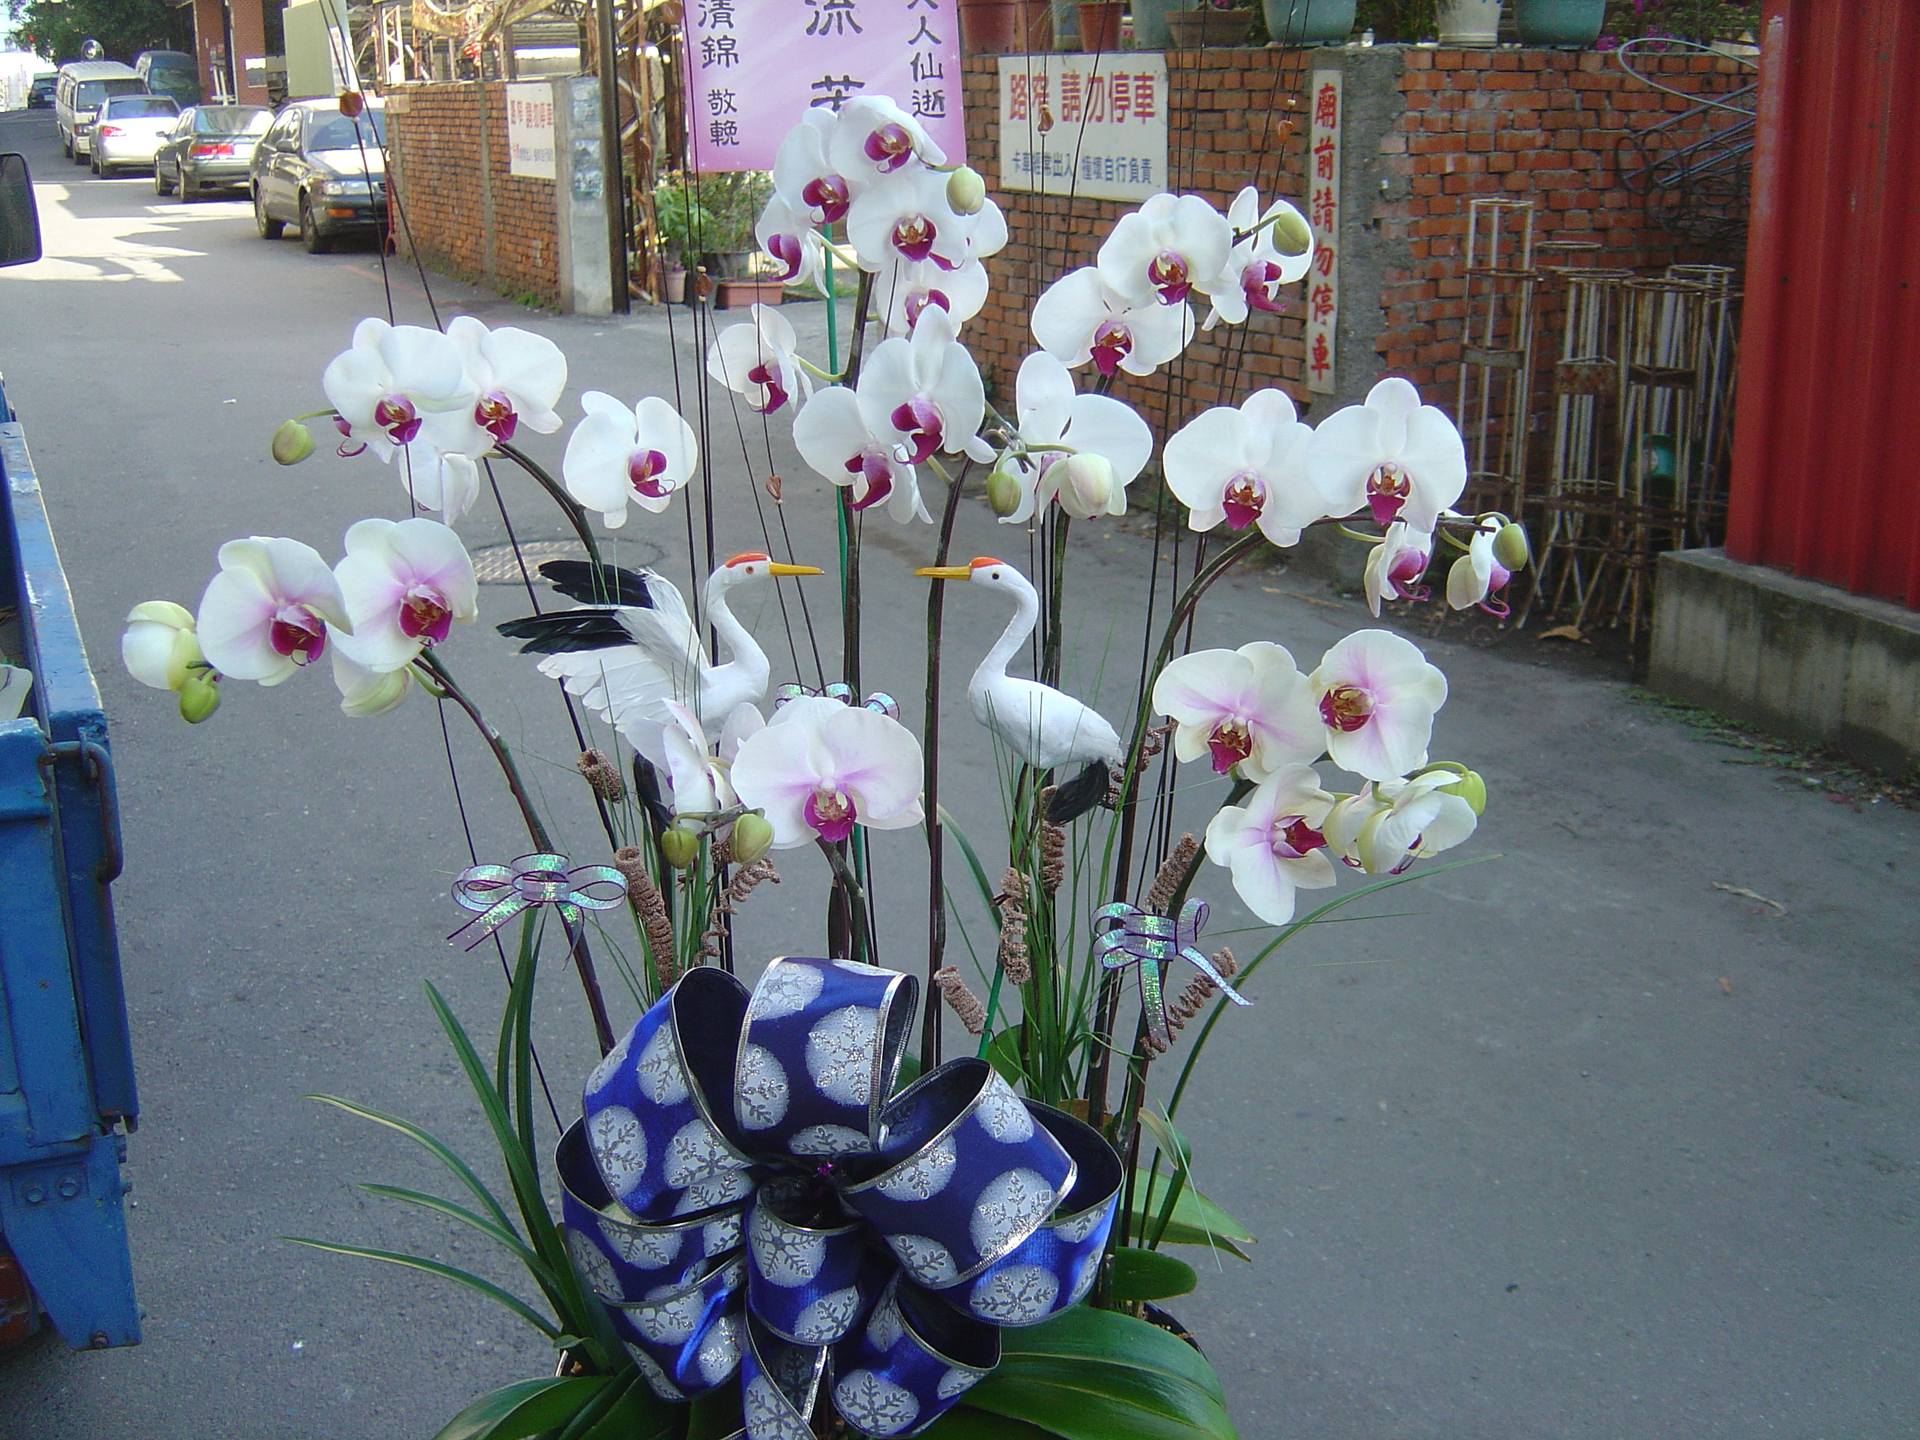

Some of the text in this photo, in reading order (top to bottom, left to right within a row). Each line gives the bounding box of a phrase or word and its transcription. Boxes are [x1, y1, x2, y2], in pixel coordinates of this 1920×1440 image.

[708, 88, 740, 147] 敬輓
[1310, 82, 1338, 382] 廟前請勿停車
